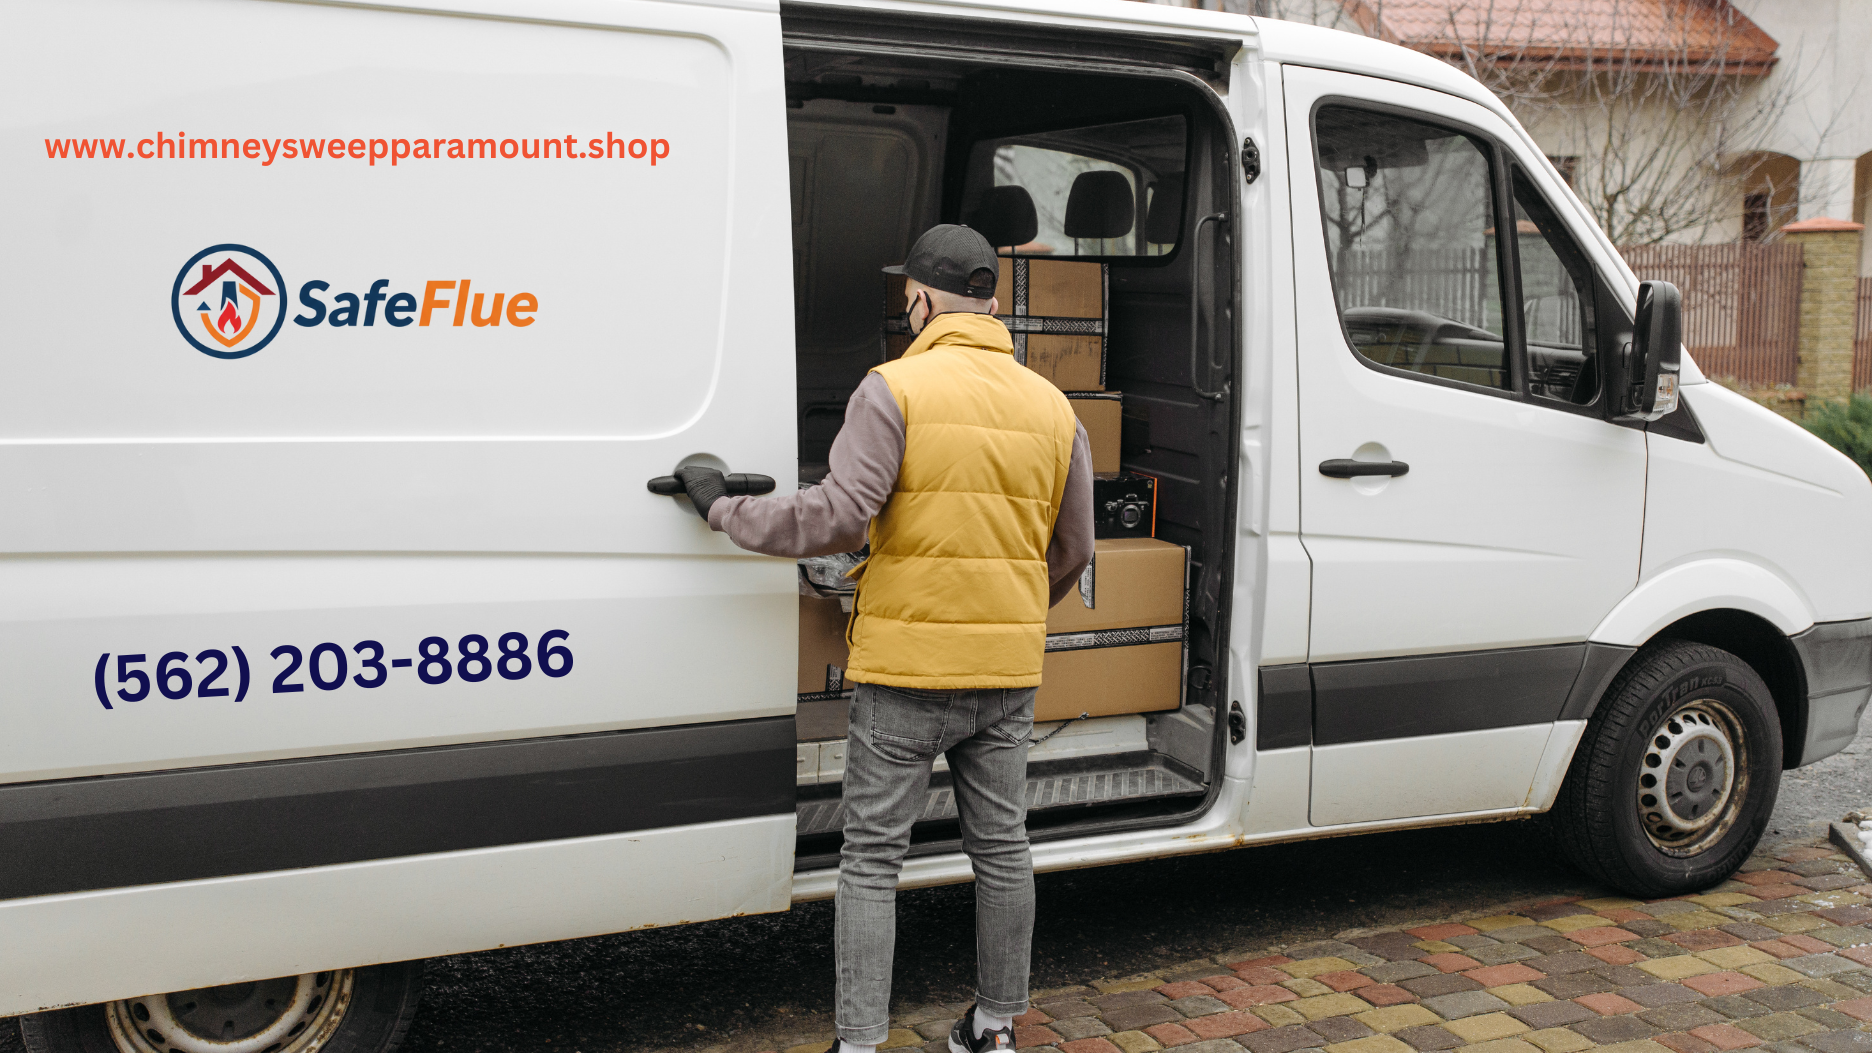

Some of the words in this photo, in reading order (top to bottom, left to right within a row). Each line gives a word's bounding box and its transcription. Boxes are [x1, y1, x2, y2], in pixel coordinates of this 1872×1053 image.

[44, 130, 670, 167] www.chimneysweepparamount.shop
[293, 278, 539, 328] SafeFlue
[94, 645, 250, 710] (562)
[270, 629, 574, 694] 203-8886
